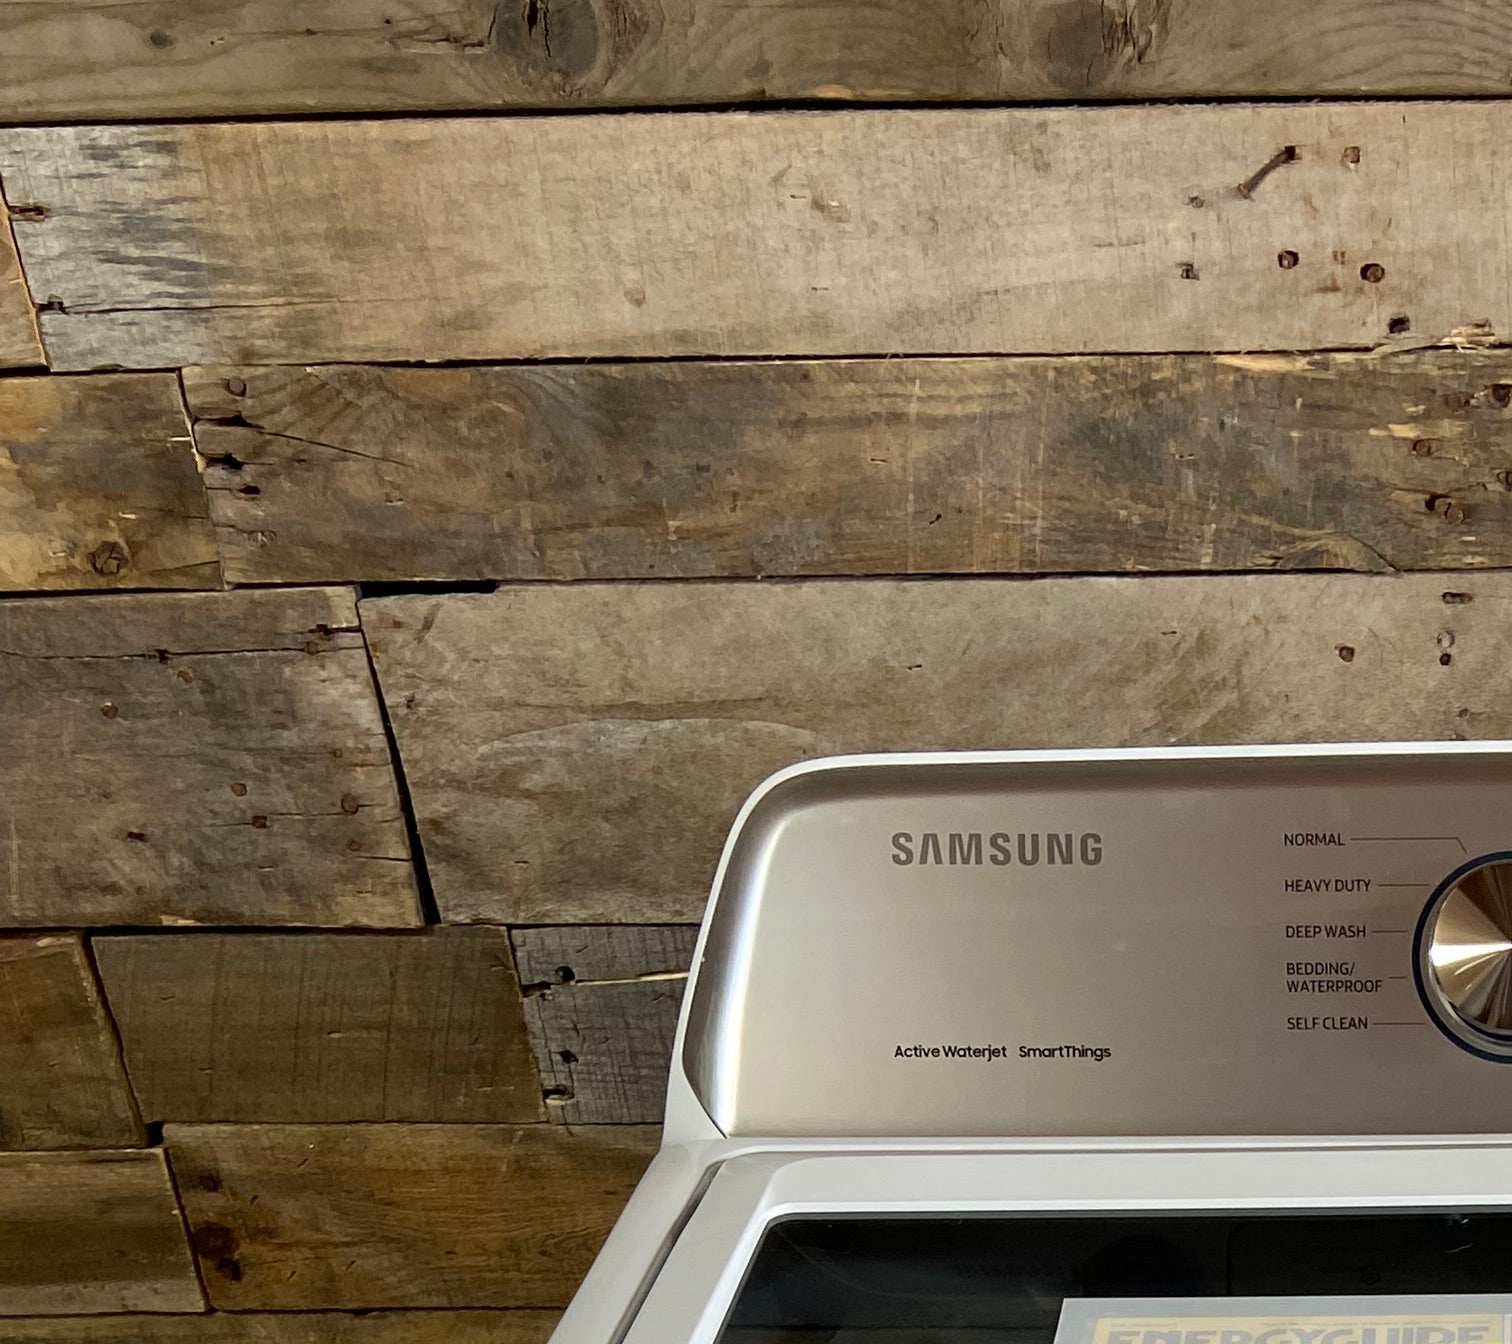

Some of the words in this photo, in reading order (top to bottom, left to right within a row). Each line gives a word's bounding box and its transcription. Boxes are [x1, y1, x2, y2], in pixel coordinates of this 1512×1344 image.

[1284, 833, 1345, 846] NORMAL
[891, 832, 1103, 866] SAMSUNG
[1285, 879, 1331, 892] HEAVY
[1335, 879, 1371, 892] DUTY
[1286, 925, 1321, 938] DEEP
[1325, 925, 1367, 938] WASH
[1287, 962, 1355, 976] BEDDING/
[1287, 979, 1383, 993] WATERPROOF
[1288, 1017, 1320, 1030] SELF
[1323, 1017, 1368, 1030] CLEAN
[895, 1045, 940, 1058] Active
[942, 1045, 1007, 1061] Waterjet
[1019, 1044, 1111, 1061] SmartThings
